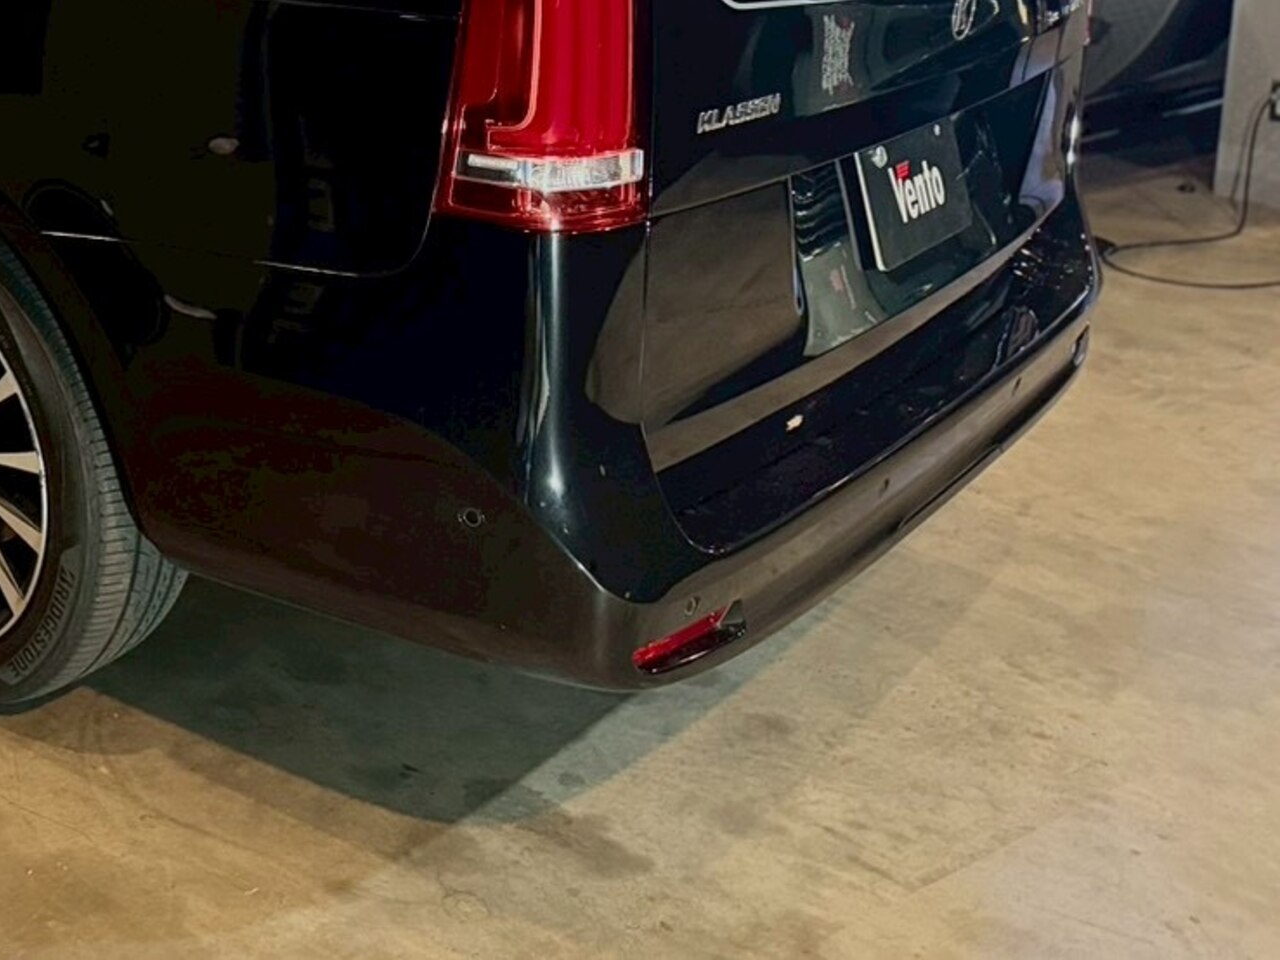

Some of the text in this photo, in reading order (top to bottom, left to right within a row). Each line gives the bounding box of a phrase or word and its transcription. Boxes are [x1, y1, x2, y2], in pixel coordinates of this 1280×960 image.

[696, 92, 781, 135] KLASSEN
[887, 160, 945, 223] Vento
[6, 565, 76, 678] BRIDGESTONE
